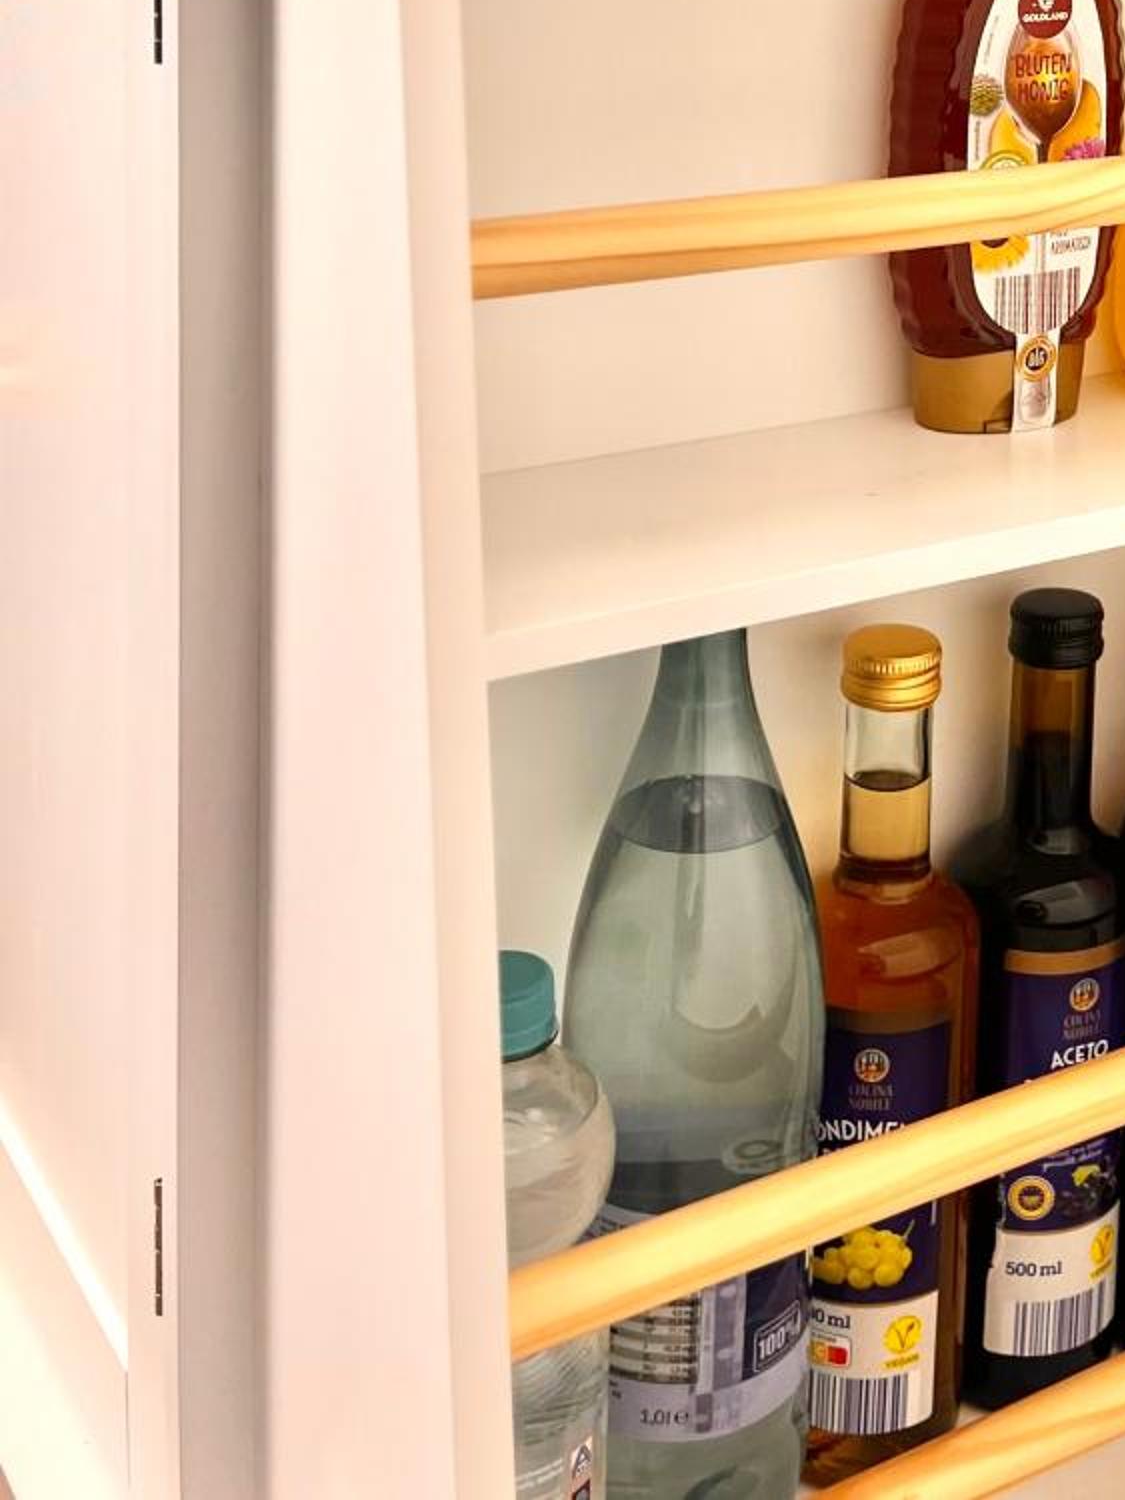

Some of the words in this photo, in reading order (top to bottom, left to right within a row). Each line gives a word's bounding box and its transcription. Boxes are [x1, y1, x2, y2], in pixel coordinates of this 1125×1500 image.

[1015, 52, 1072, 77] BLUTEN
[1017, 78, 1069, 101] HONIG
[1051, 1039, 1109, 1070] ACETO
[1005, 1260, 1037, 1277] 500
[1040, 1259, 1063, 1277] ml
[827, 1315, 850, 1329] ml
